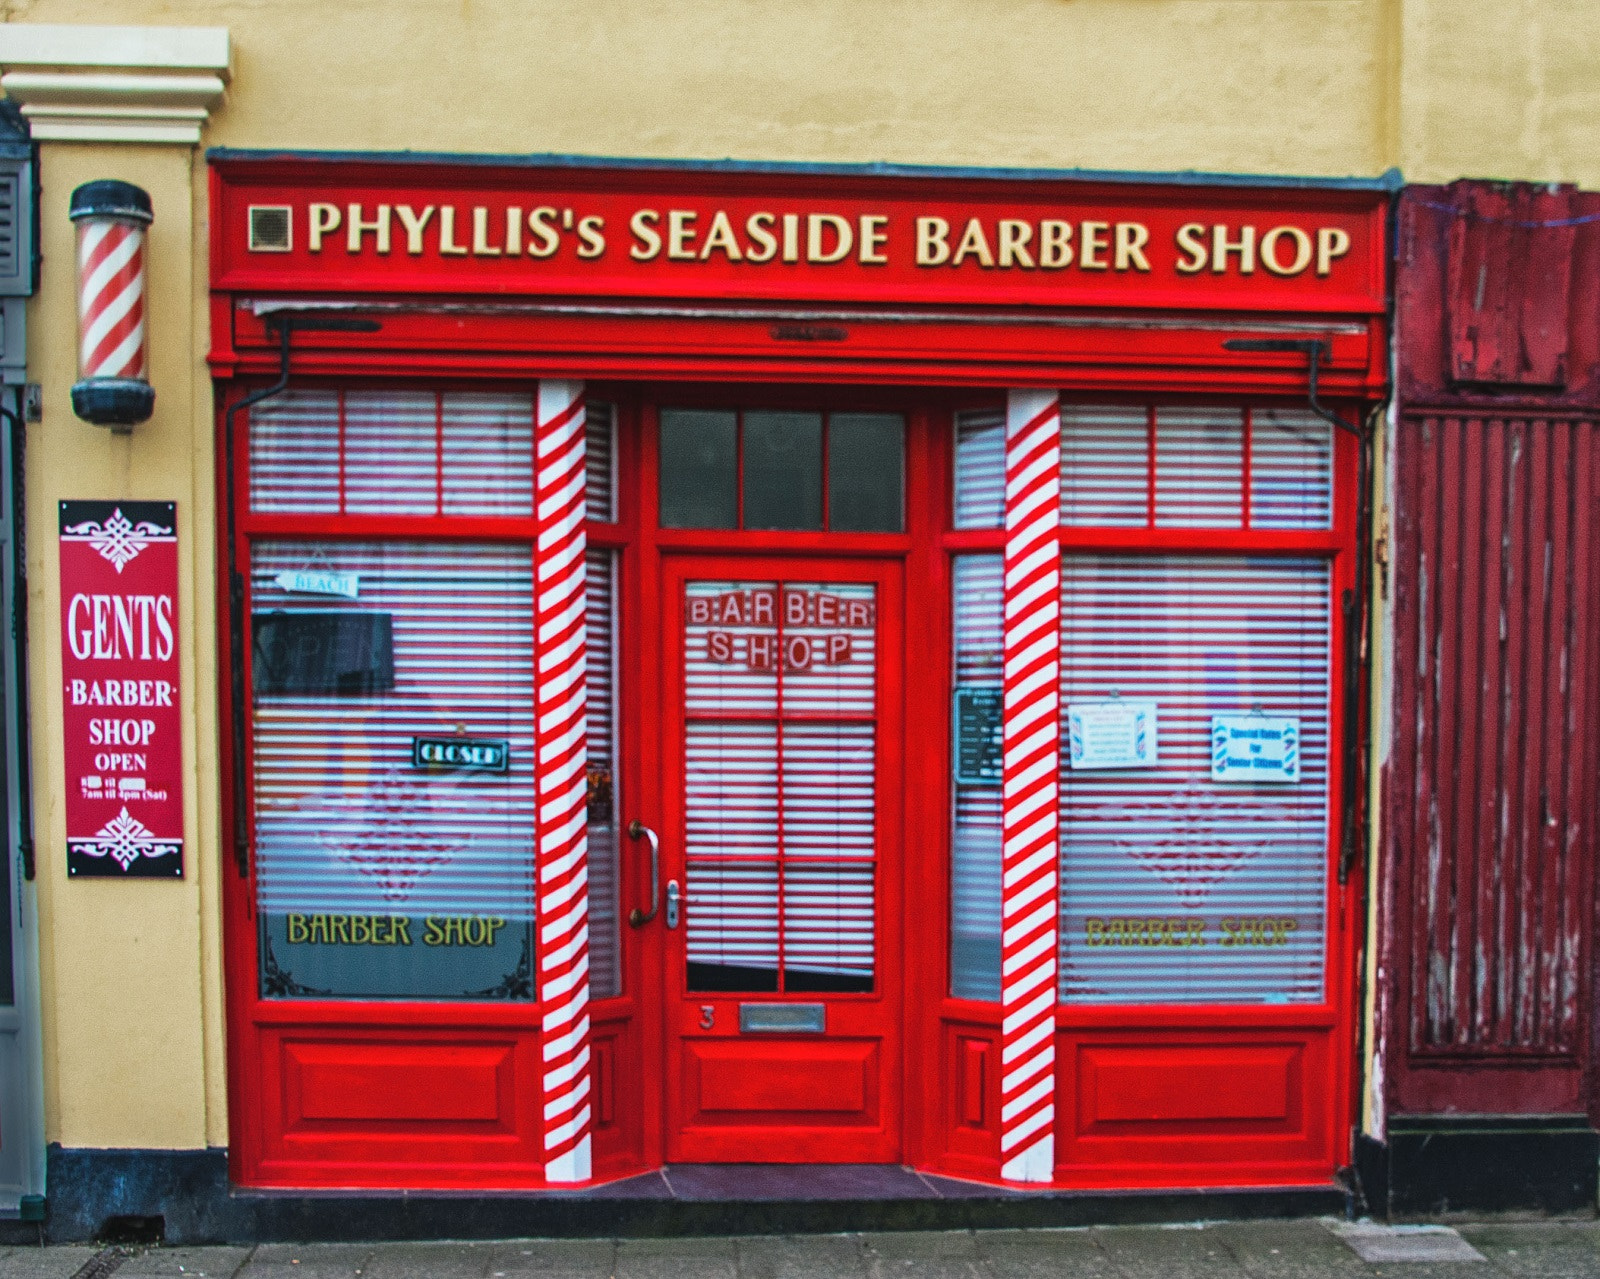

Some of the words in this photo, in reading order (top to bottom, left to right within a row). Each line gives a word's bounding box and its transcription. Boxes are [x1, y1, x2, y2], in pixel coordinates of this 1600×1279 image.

[308, 202, 605, 258] PHYLLIS's
[630, 209, 889, 265] SEASIDE
[915, 216, 1151, 272] BARBER
[1175, 223, 1350, 276] SHOP
[691, 592, 868, 627] BARBER
[67, 592, 174, 662] GENTS
[711, 632, 848, 668] SHOP
[89, 718, 156, 746] SHOP
[94, 752, 147, 772] OPEN
[421, 743, 502, 765] CLOSED
[286, 912, 410, 944] BARBER
[423, 914, 506, 946] SHOP
[1086, 918, 1205, 947] BARBER
[1219, 918, 1298, 947] SHOP
[699, 1005, 715, 1030] 3
